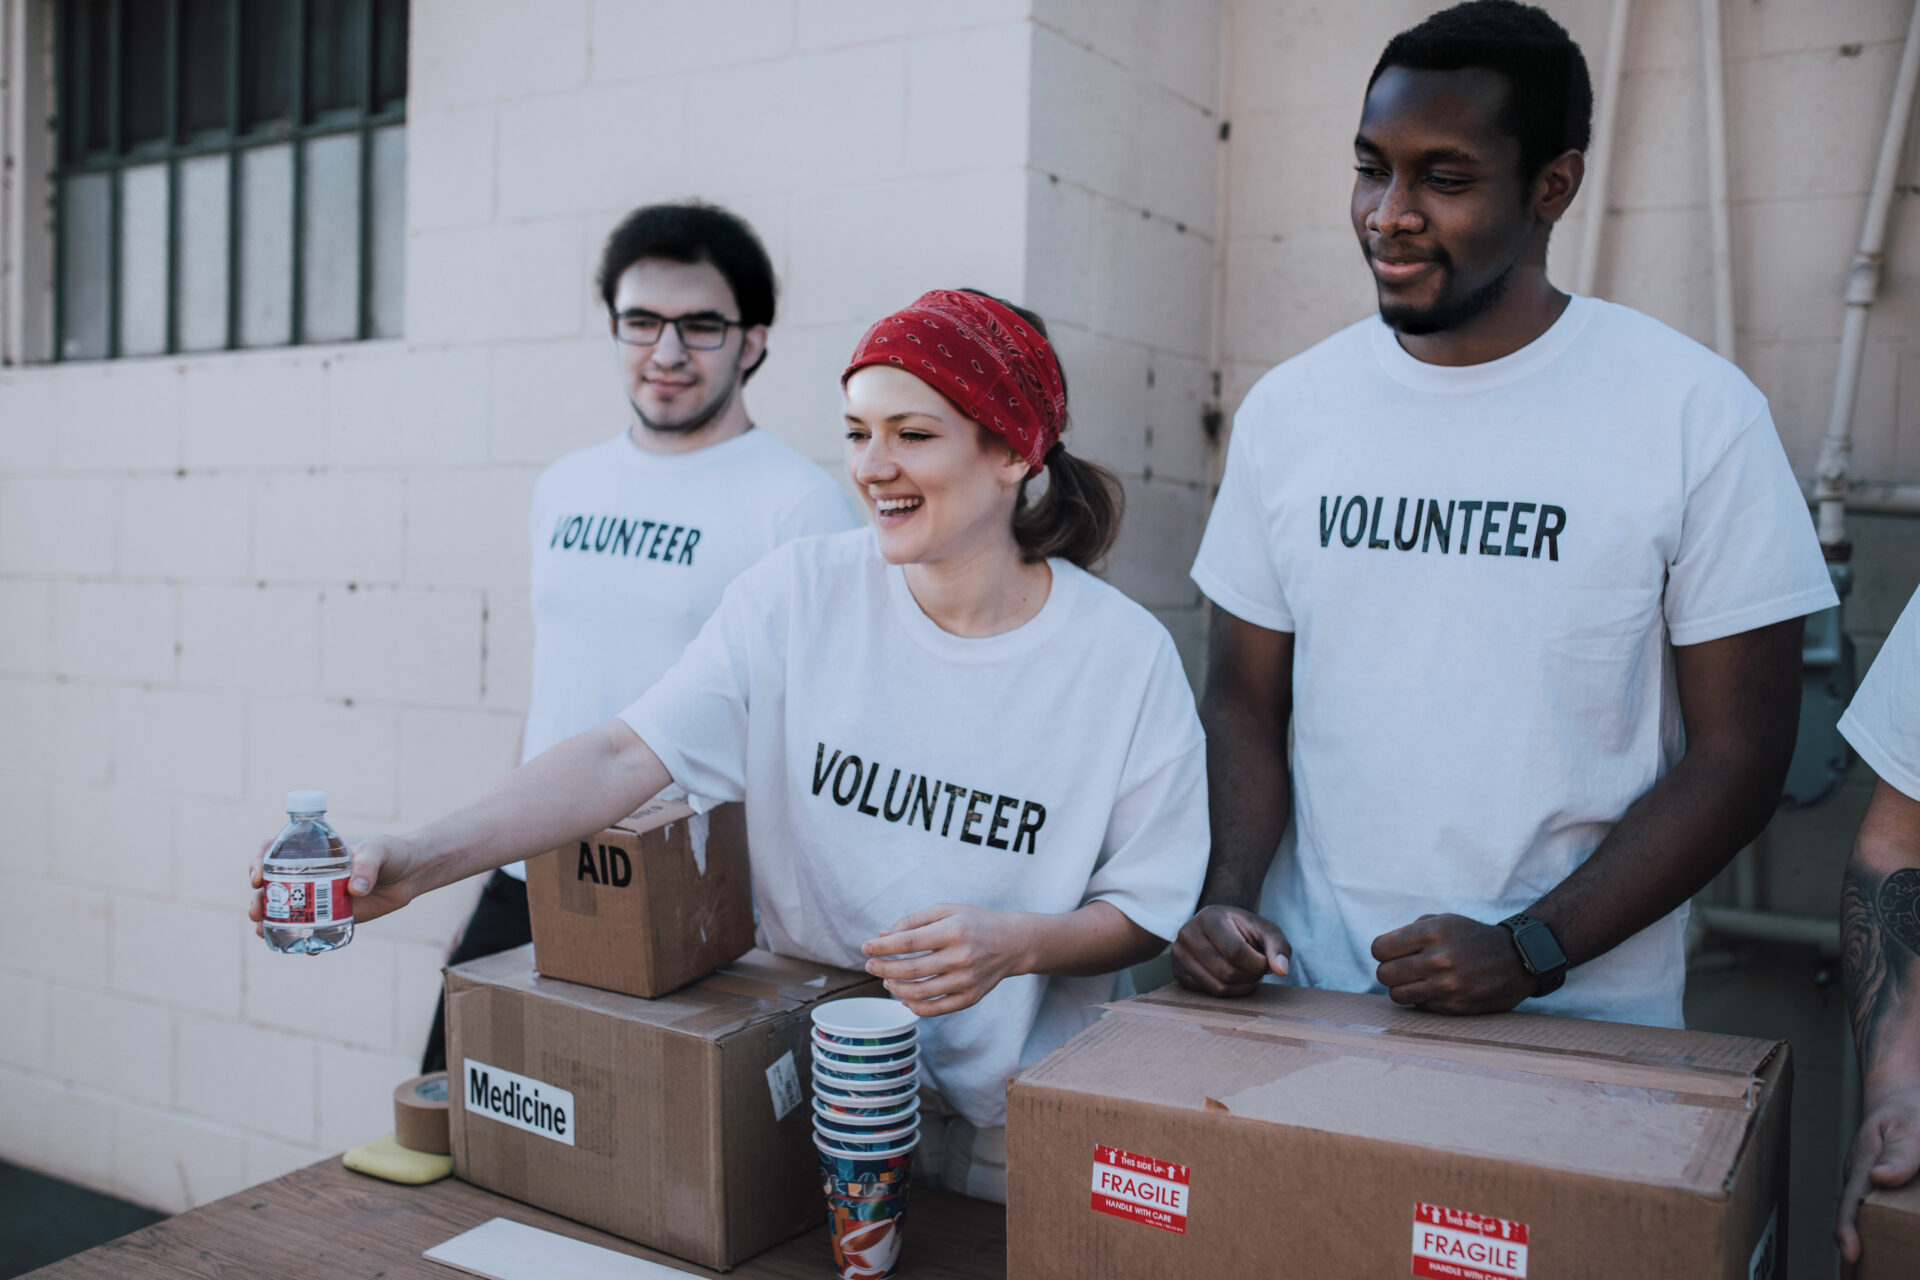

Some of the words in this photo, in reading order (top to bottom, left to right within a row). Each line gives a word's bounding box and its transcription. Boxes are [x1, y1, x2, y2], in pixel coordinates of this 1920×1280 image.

[550, 515, 702, 566] VOLUNTEER
[1320, 495, 1567, 562] VOLUNTEER
[811, 742, 1047, 855] VOLUNTEER
[577, 841, 633, 888] AID
[470, 1067, 567, 1136] Medicine
[1121, 1156, 1135, 1166] THIS
[1136, 1160, 1151, 1171] SIDE
[1101, 1171, 1181, 1209] FRAGILE
[1105, 1199, 1133, 1212] HANDLE
[1134, 1207, 1151, 1217] WITH
[1152, 1211, 1171, 1223] CARE
[1424, 1232, 1518, 1270] FRAGILE
[1428, 1262, 1462, 1277] HANDLE
